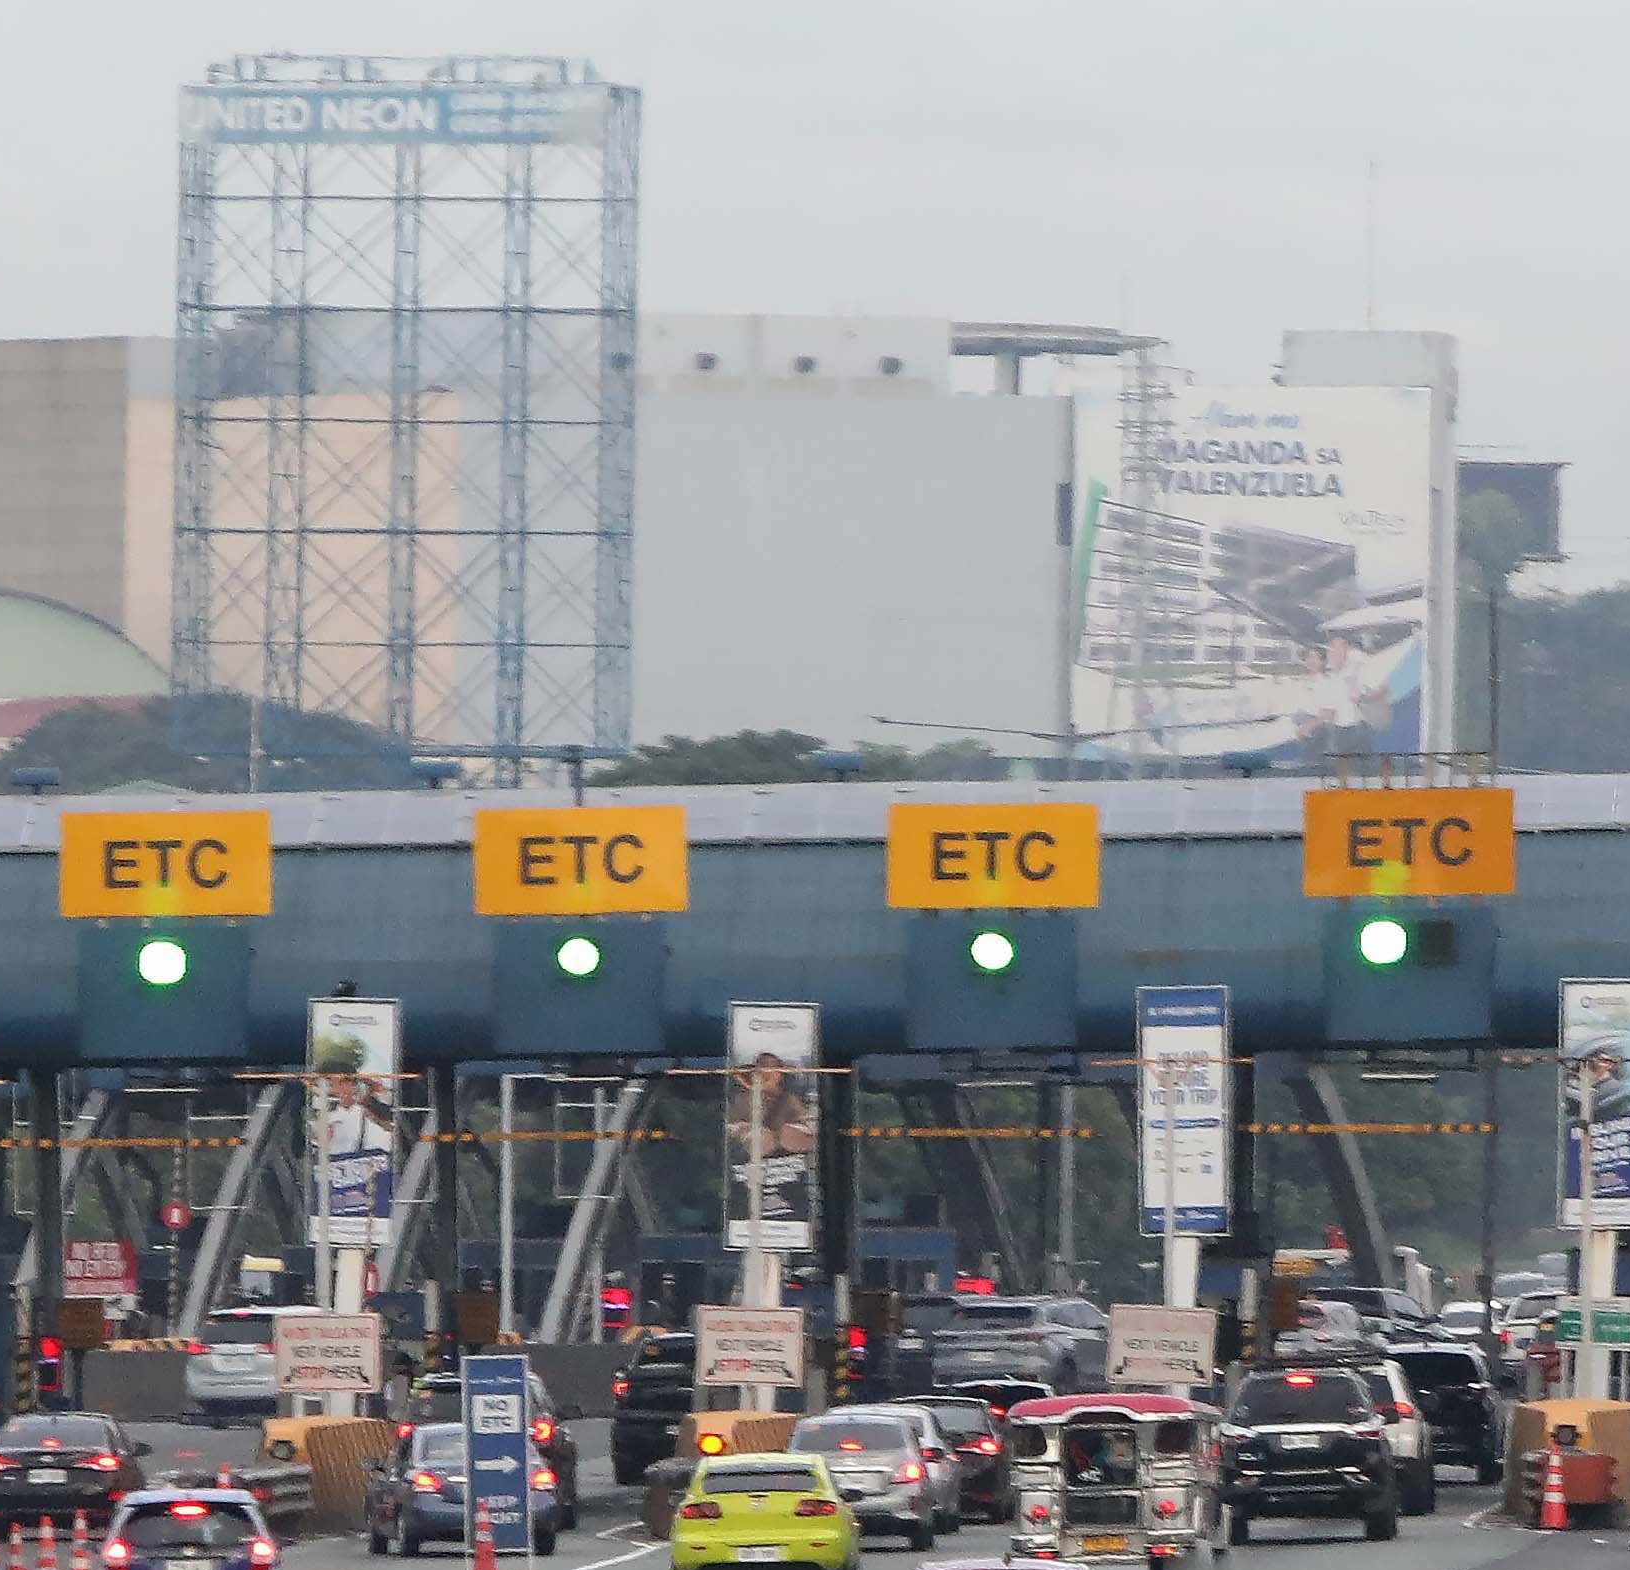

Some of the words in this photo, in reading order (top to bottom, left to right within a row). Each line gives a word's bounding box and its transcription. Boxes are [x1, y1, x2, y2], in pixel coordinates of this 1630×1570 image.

[190, 100, 309, 131] UNITED
[322, 99, 435, 131] NEON
[931, 832, 1055, 881] ETC
[1347, 817, 1473, 867] ETC
[104, 840, 228, 888] ETC
[519, 835, 643, 885] ETC
[320, 1345, 362, 1359] VEHICLE
[745, 1339, 787, 1352] VEHICLE
[482, 1398, 508, 1412] NO
[481, 1415, 512, 1428] ETC
